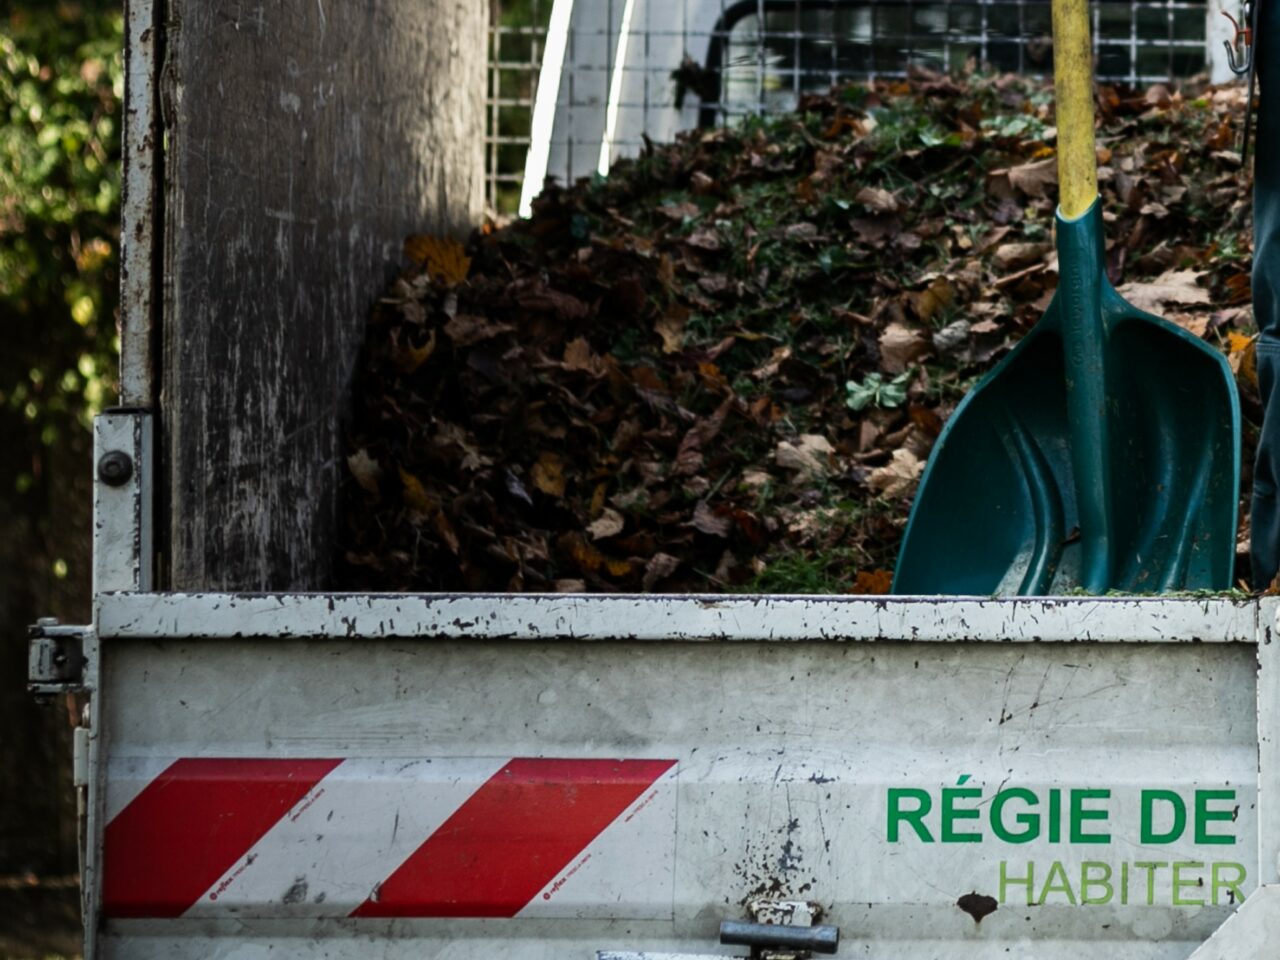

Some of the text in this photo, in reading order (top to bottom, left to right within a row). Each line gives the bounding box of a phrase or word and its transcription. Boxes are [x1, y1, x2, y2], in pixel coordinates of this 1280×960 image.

[886, 774, 1113, 847] RÉGIE
[1138, 787, 1238, 847] DE
[997, 860, 1248, 908] HABITER
